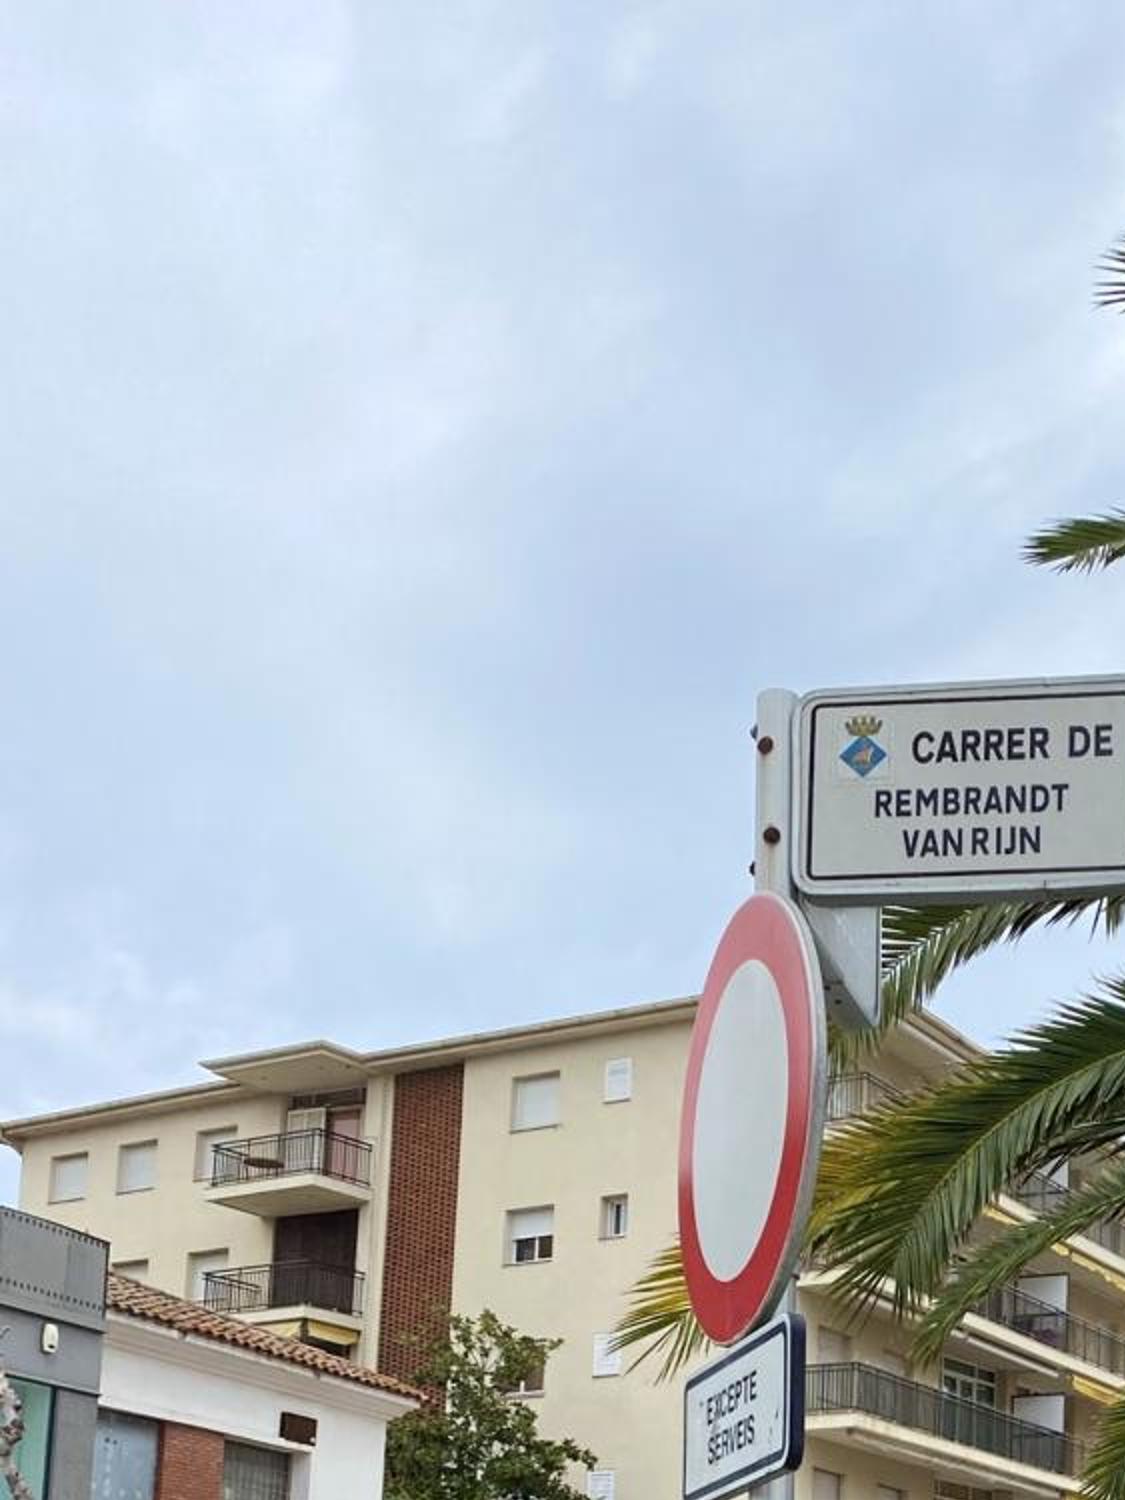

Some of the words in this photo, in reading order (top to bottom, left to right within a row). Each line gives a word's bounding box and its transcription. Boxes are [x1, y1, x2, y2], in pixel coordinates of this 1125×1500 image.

[912, 727, 1050, 764] CARRER
[1068, 724, 1114, 758] DE
[874, 784, 1069, 818] REMBRANDT
[707, 1370, 757, 1426] EXCEPTE
[708, 1414, 755, 1465] SERVEIS
